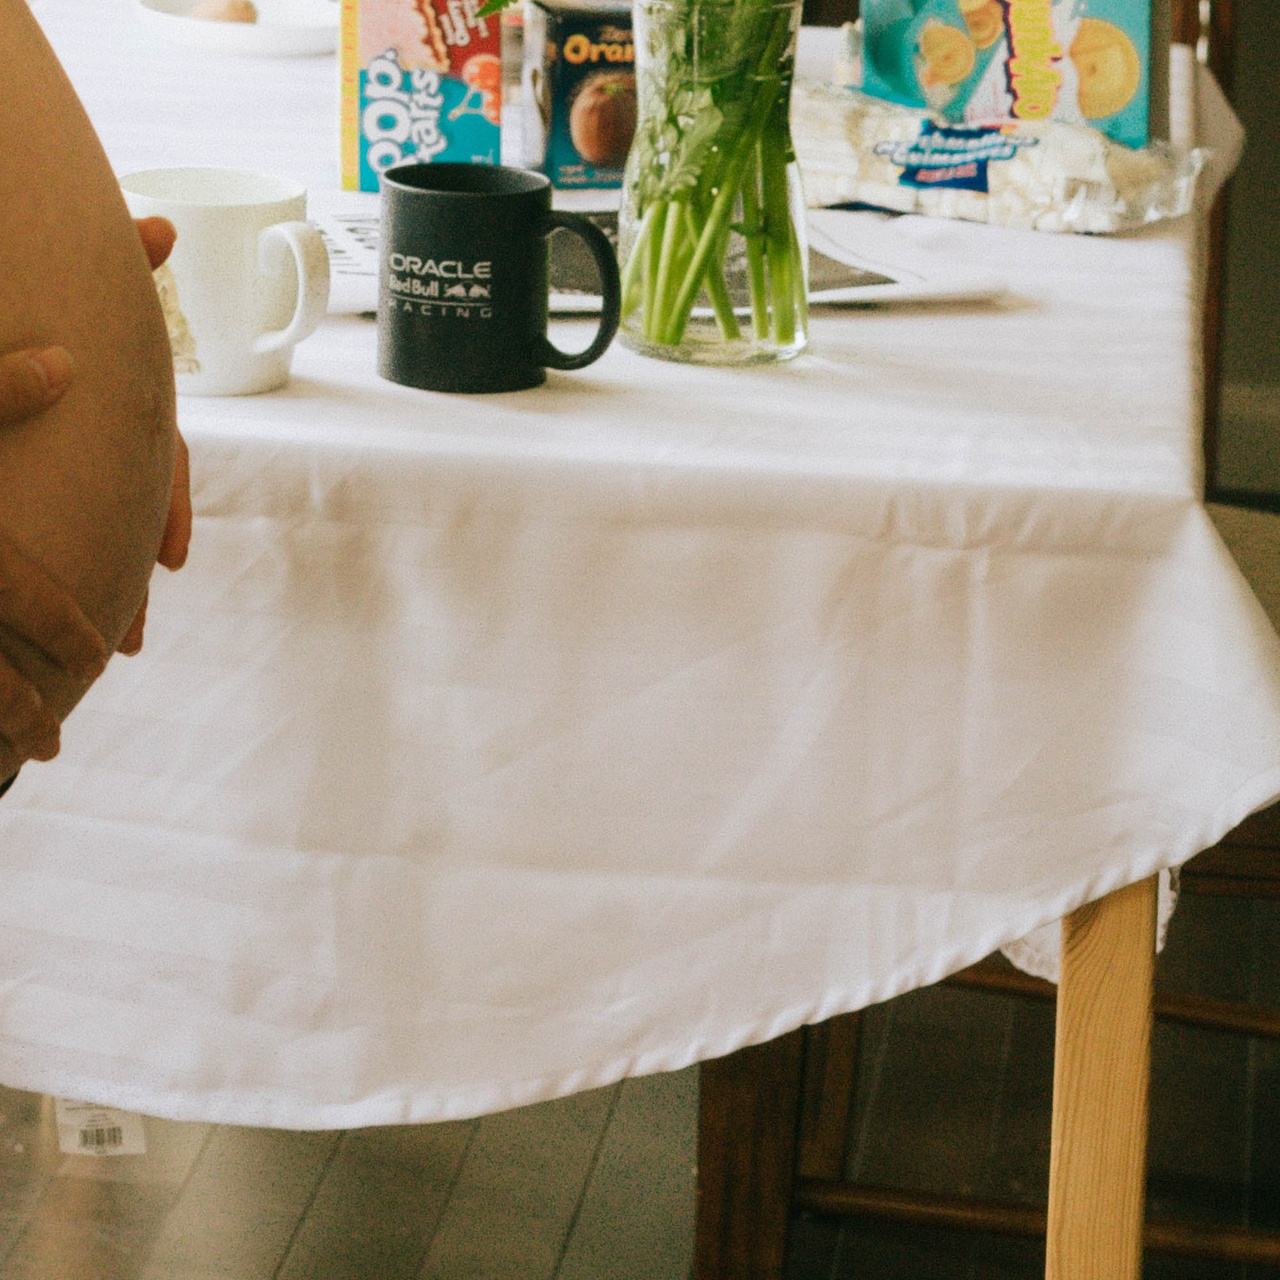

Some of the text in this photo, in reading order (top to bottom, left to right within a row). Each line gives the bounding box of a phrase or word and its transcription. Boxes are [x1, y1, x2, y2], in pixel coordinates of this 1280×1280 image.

[563, 33, 635, 65] Ora
[389, 252, 492, 279] ORACLE
[412, 278, 439, 298] Bull
[388, 297, 493, 318] RACING
